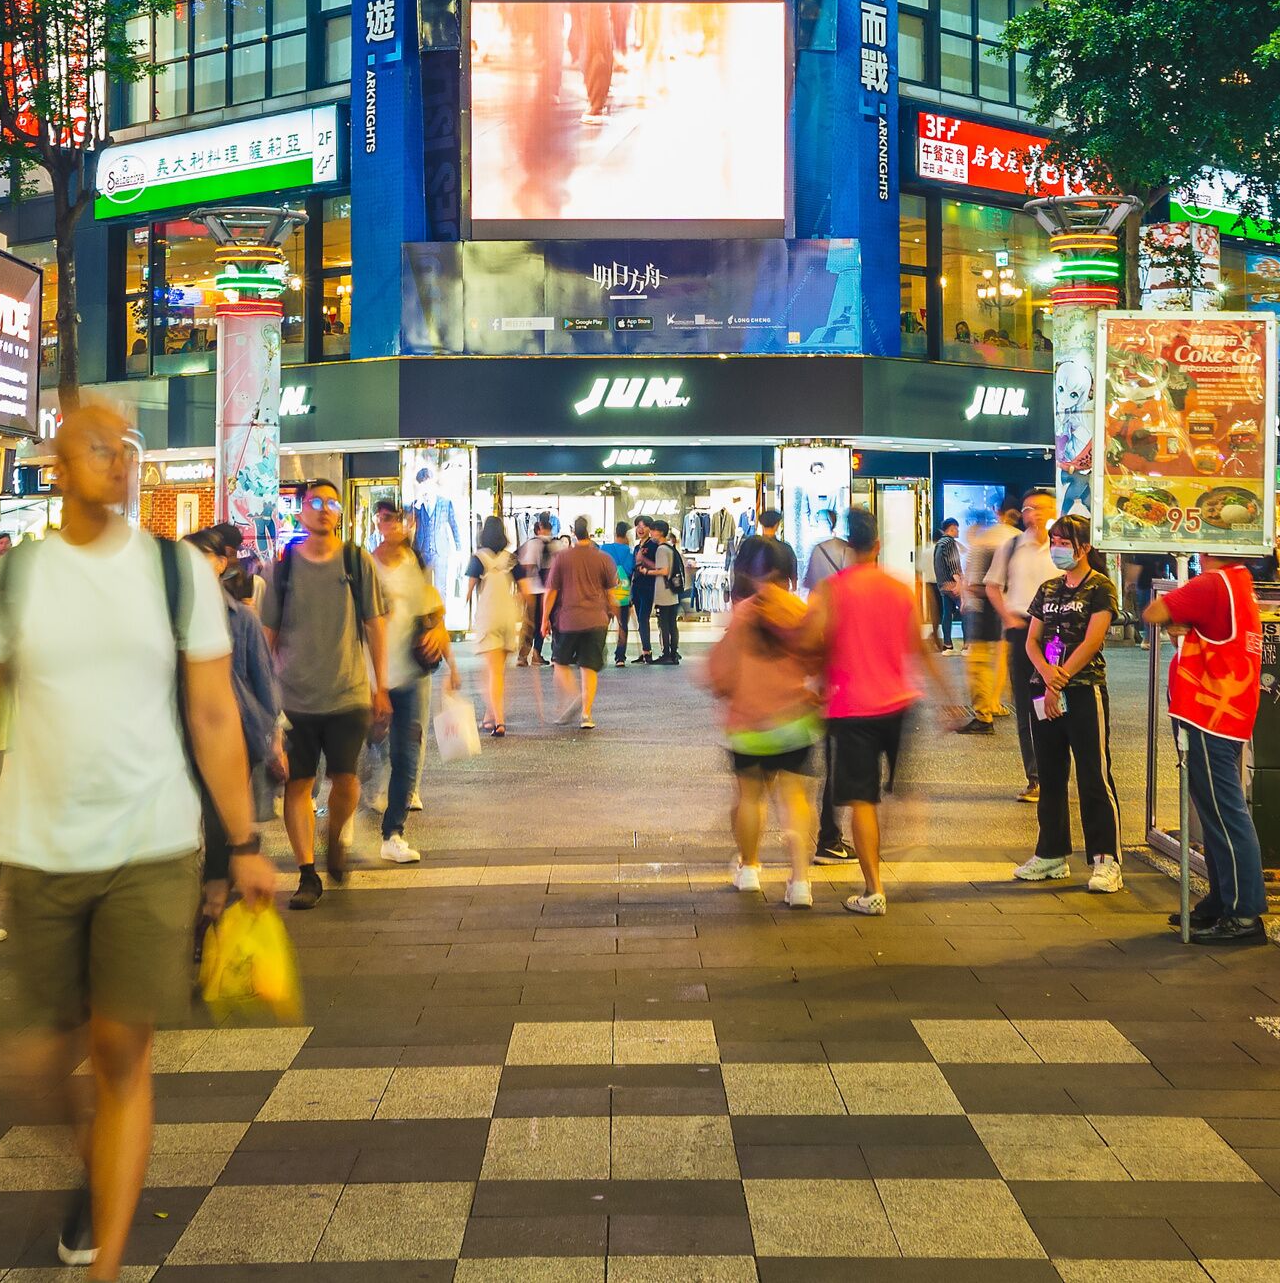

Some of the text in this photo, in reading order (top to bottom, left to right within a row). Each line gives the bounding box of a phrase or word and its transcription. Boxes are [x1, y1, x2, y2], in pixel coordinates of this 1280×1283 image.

[366, 70, 377, 153] ARKNIGHTS
[317, 131, 332, 147] 2F
[926, 114, 946, 139] 3F
[157, 146, 239, 176] 義大利料理
[877, 116, 889, 201] ARKNIGHTS
[922, 142, 965, 166] 午餐定食
[586, 262, 668, 295] 明日方舟
[575, 319, 602, 327] Google Play
[1175, 345, 1225, 363] Coke
[574, 376, 684, 416] JUN
[965, 385, 1027, 422] JUN
[601, 448, 647, 468] JUN
[1167, 507, 1202, 534] 95
